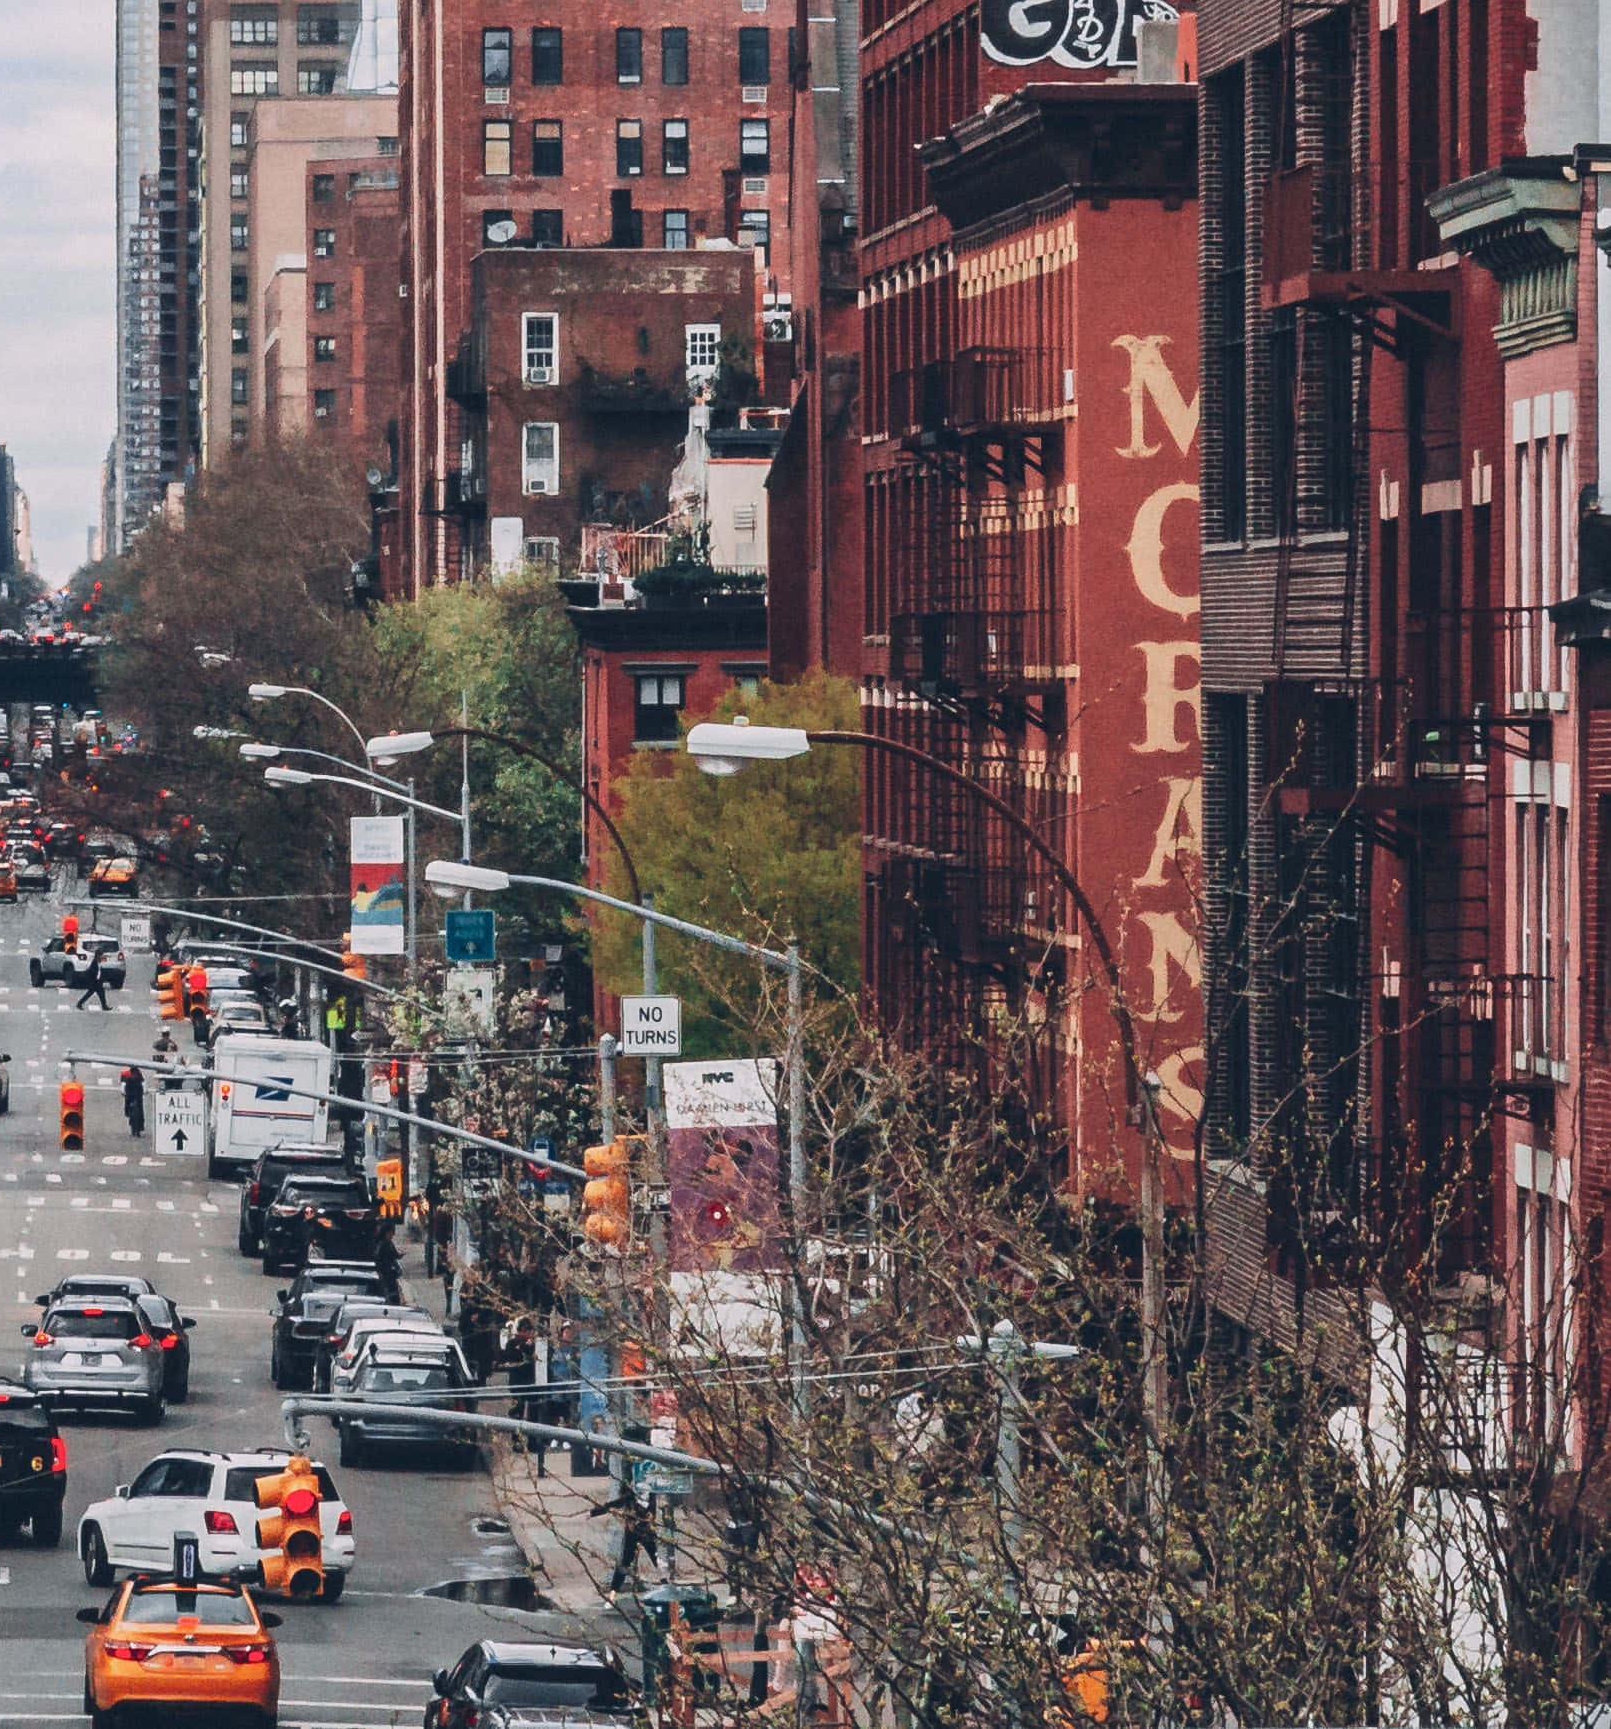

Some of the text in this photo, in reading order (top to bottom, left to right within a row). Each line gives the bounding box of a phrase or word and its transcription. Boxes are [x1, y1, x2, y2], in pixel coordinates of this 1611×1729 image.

[638, 1006, 663, 1023] NO
[626, 1030, 677, 1045] TURNS
[168, 1095, 191, 1109] ALL
[158, 1112, 203, 1126] TRAFFIC
